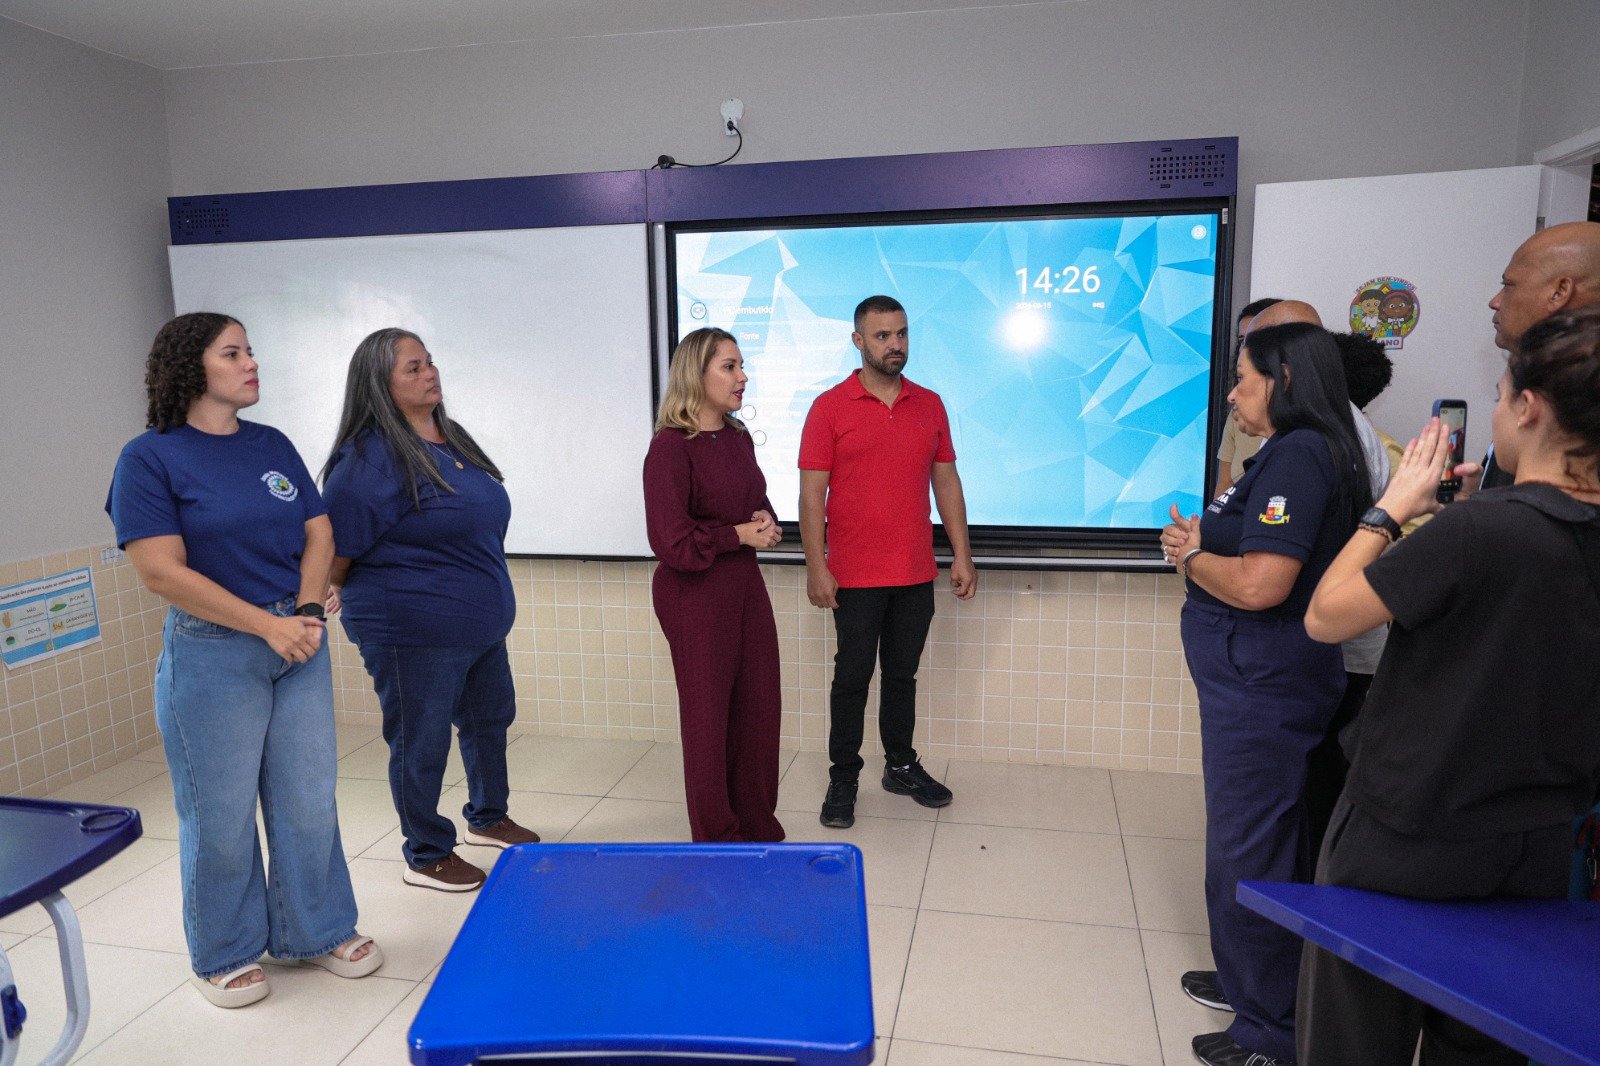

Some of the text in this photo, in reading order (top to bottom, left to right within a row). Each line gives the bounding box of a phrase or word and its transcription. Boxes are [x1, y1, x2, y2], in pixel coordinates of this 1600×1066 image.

[1015, 265, 1100, 294] 14:26
[736, 306, 774, 314] embutido
[739, 332, 760, 340] Fonte
